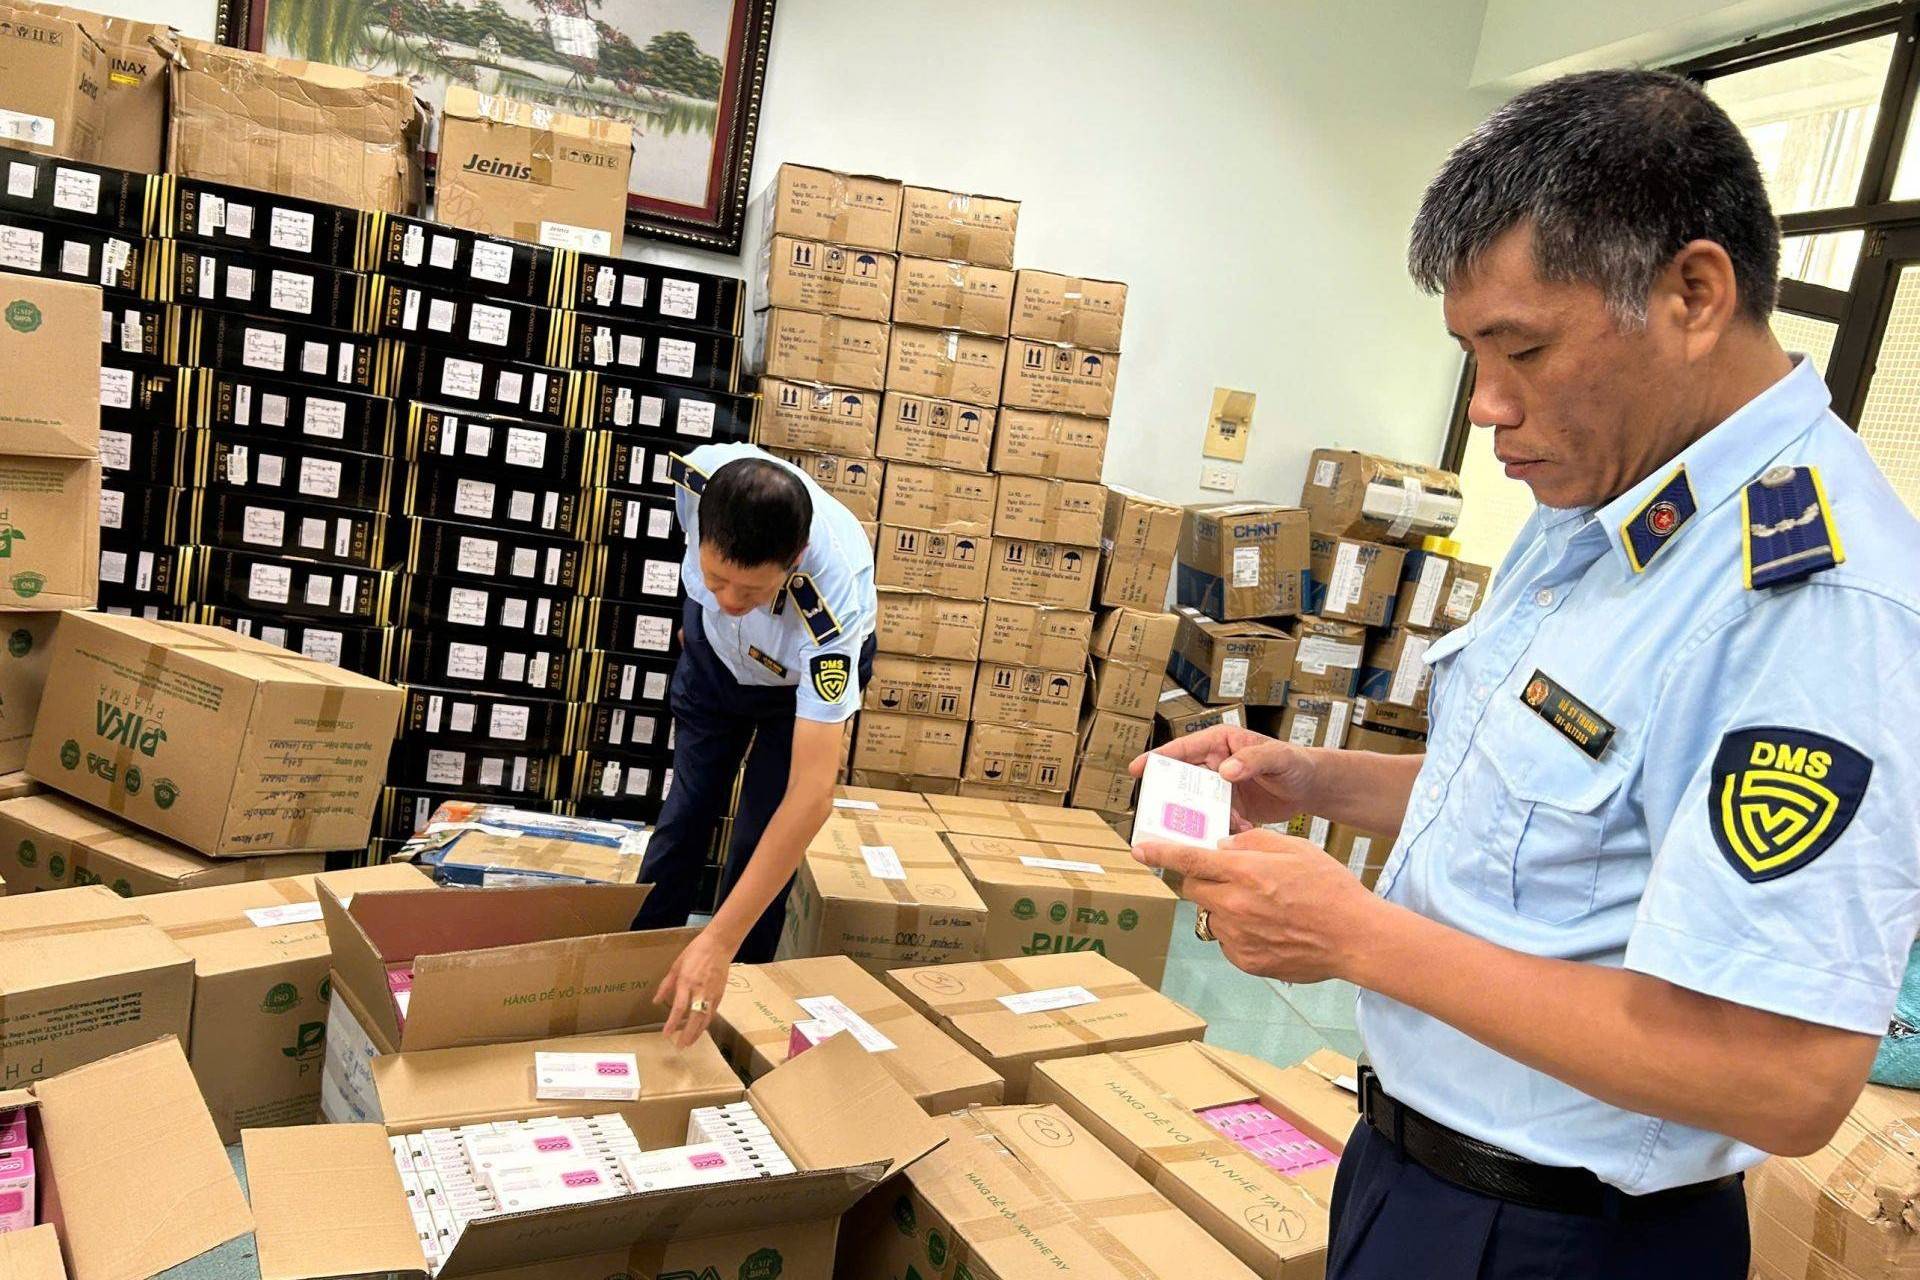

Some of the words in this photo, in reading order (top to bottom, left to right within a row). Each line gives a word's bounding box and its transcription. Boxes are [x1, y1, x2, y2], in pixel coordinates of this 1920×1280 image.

[111, 58, 147, 76] INAX
[463, 153, 532, 180] Jeinis
[1234, 522, 1280, 538] CHNT
[820, 660, 844, 669] DMS
[100, 685, 165, 720] PHARMA
[96, 699, 168, 758] PIKA
[86, 752, 119, 783] FDA
[1750, 741, 1832, 779] DMS
[1076, 908, 1109, 925] FDA
[1021, 932, 1107, 957] PIKA
[582, 984, 602, 996] XIN
[631, 980, 649, 991] TAY
[1200, 1148, 1225, 1170] XIN
[1262, 1193, 1299, 1218] TAY
[1016, 1223, 1034, 1238] XIN
[1049, 1255, 1070, 1272] TAY
